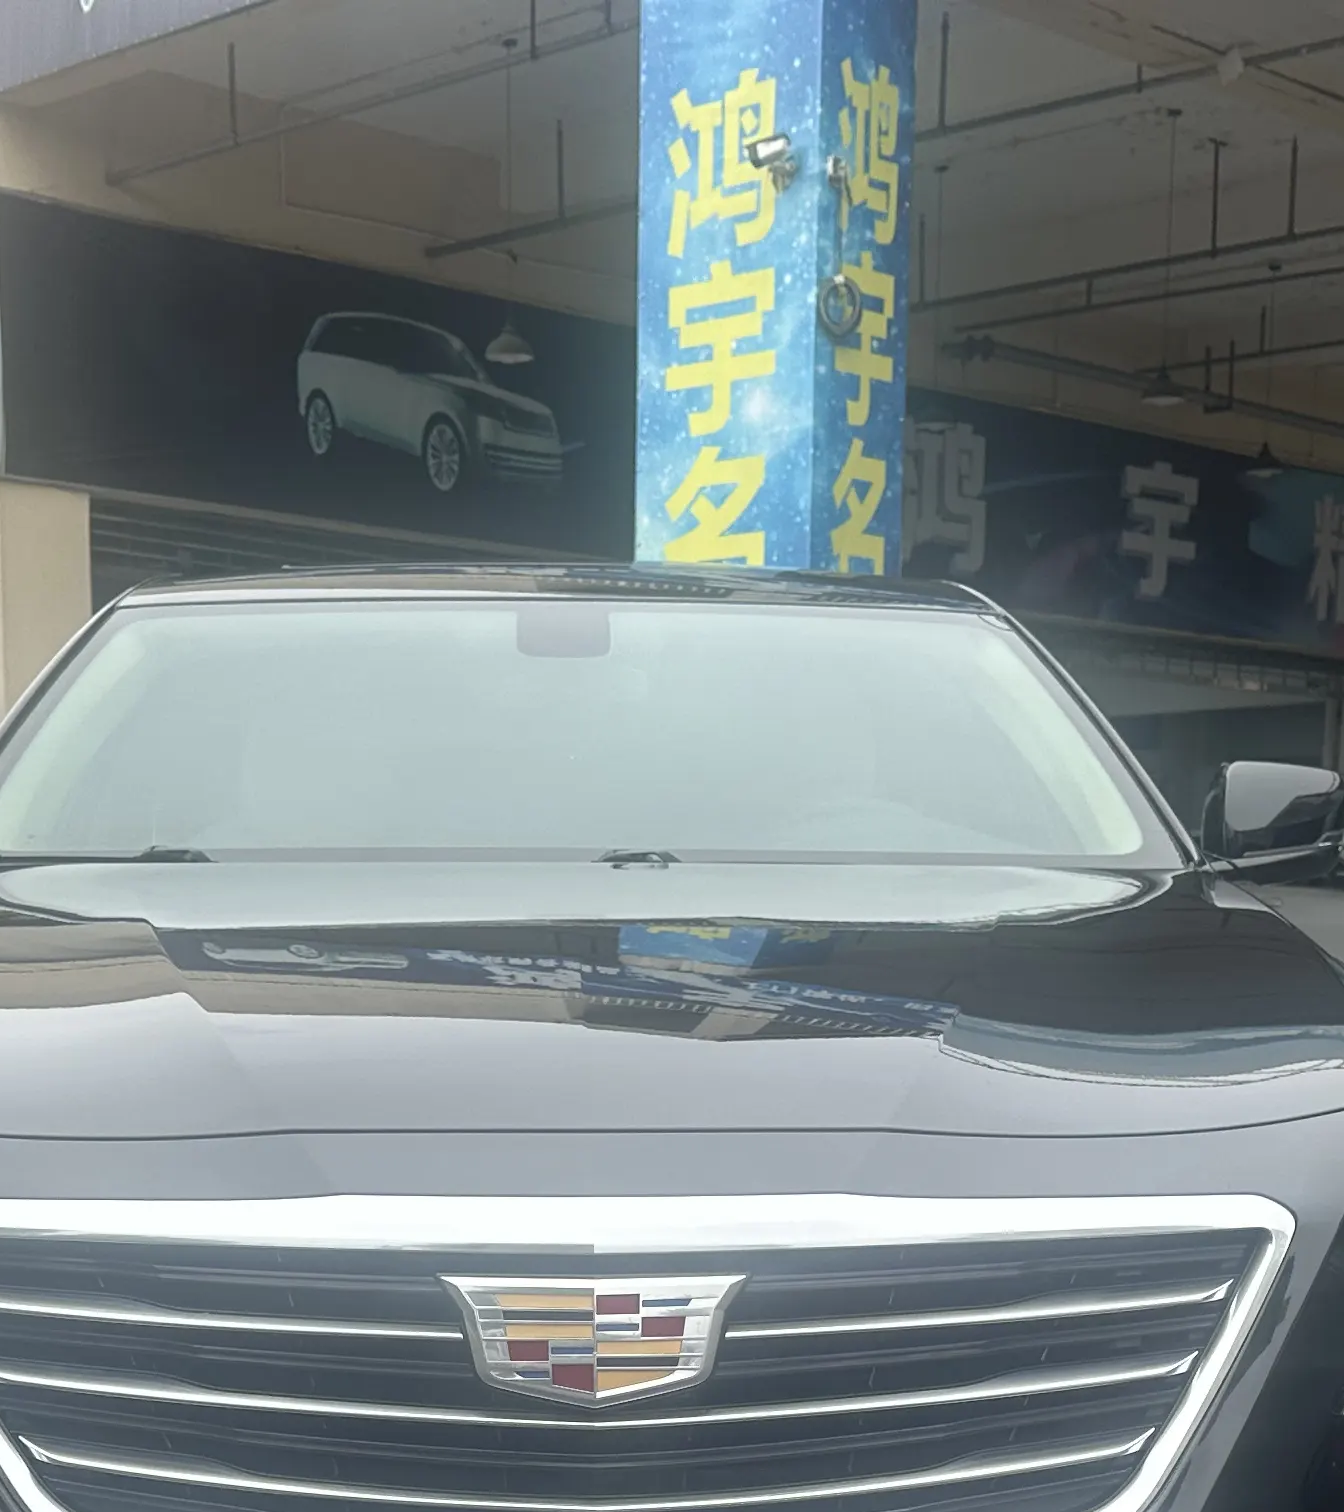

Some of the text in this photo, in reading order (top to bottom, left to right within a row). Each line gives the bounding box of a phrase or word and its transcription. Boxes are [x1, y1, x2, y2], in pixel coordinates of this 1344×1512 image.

[664, 67, 777, 567] 鸿宇名
[829, 56, 901, 576] 鸿宇名
